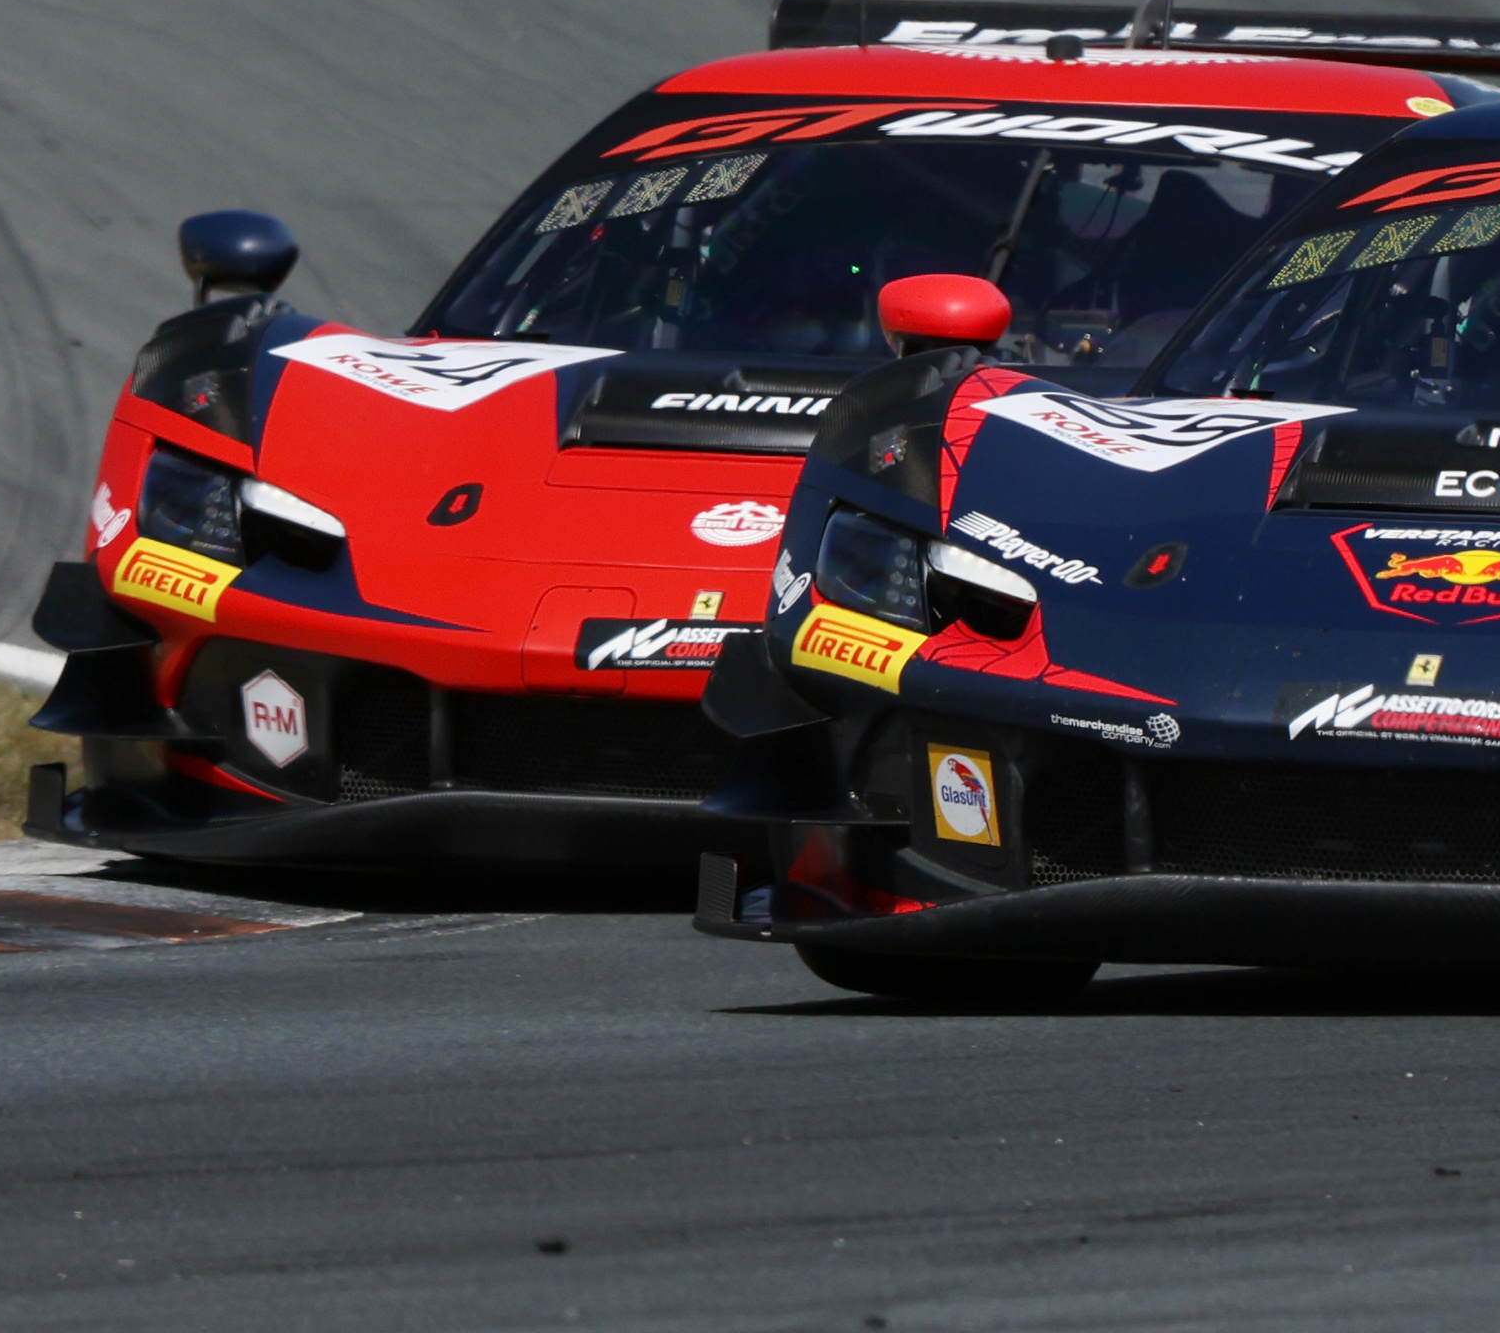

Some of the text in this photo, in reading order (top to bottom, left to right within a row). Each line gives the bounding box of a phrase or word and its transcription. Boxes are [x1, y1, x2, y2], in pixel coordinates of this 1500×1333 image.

[601, 103, 1364, 176] GT WORL
[326, 353, 440, 396] ROWE
[1030, 409, 1147, 456] ROWE
[122, 549, 219, 605] PIRELLI
[1390, 582, 1462, 604] Red
[673, 627, 750, 643] ASSET
[801, 617, 904, 675] PIRELLI
[253, 700, 298, 735] R-M
[1051, 713, 1144, 737] themerchandise
[940, 784, 987, 809] Glasurit
